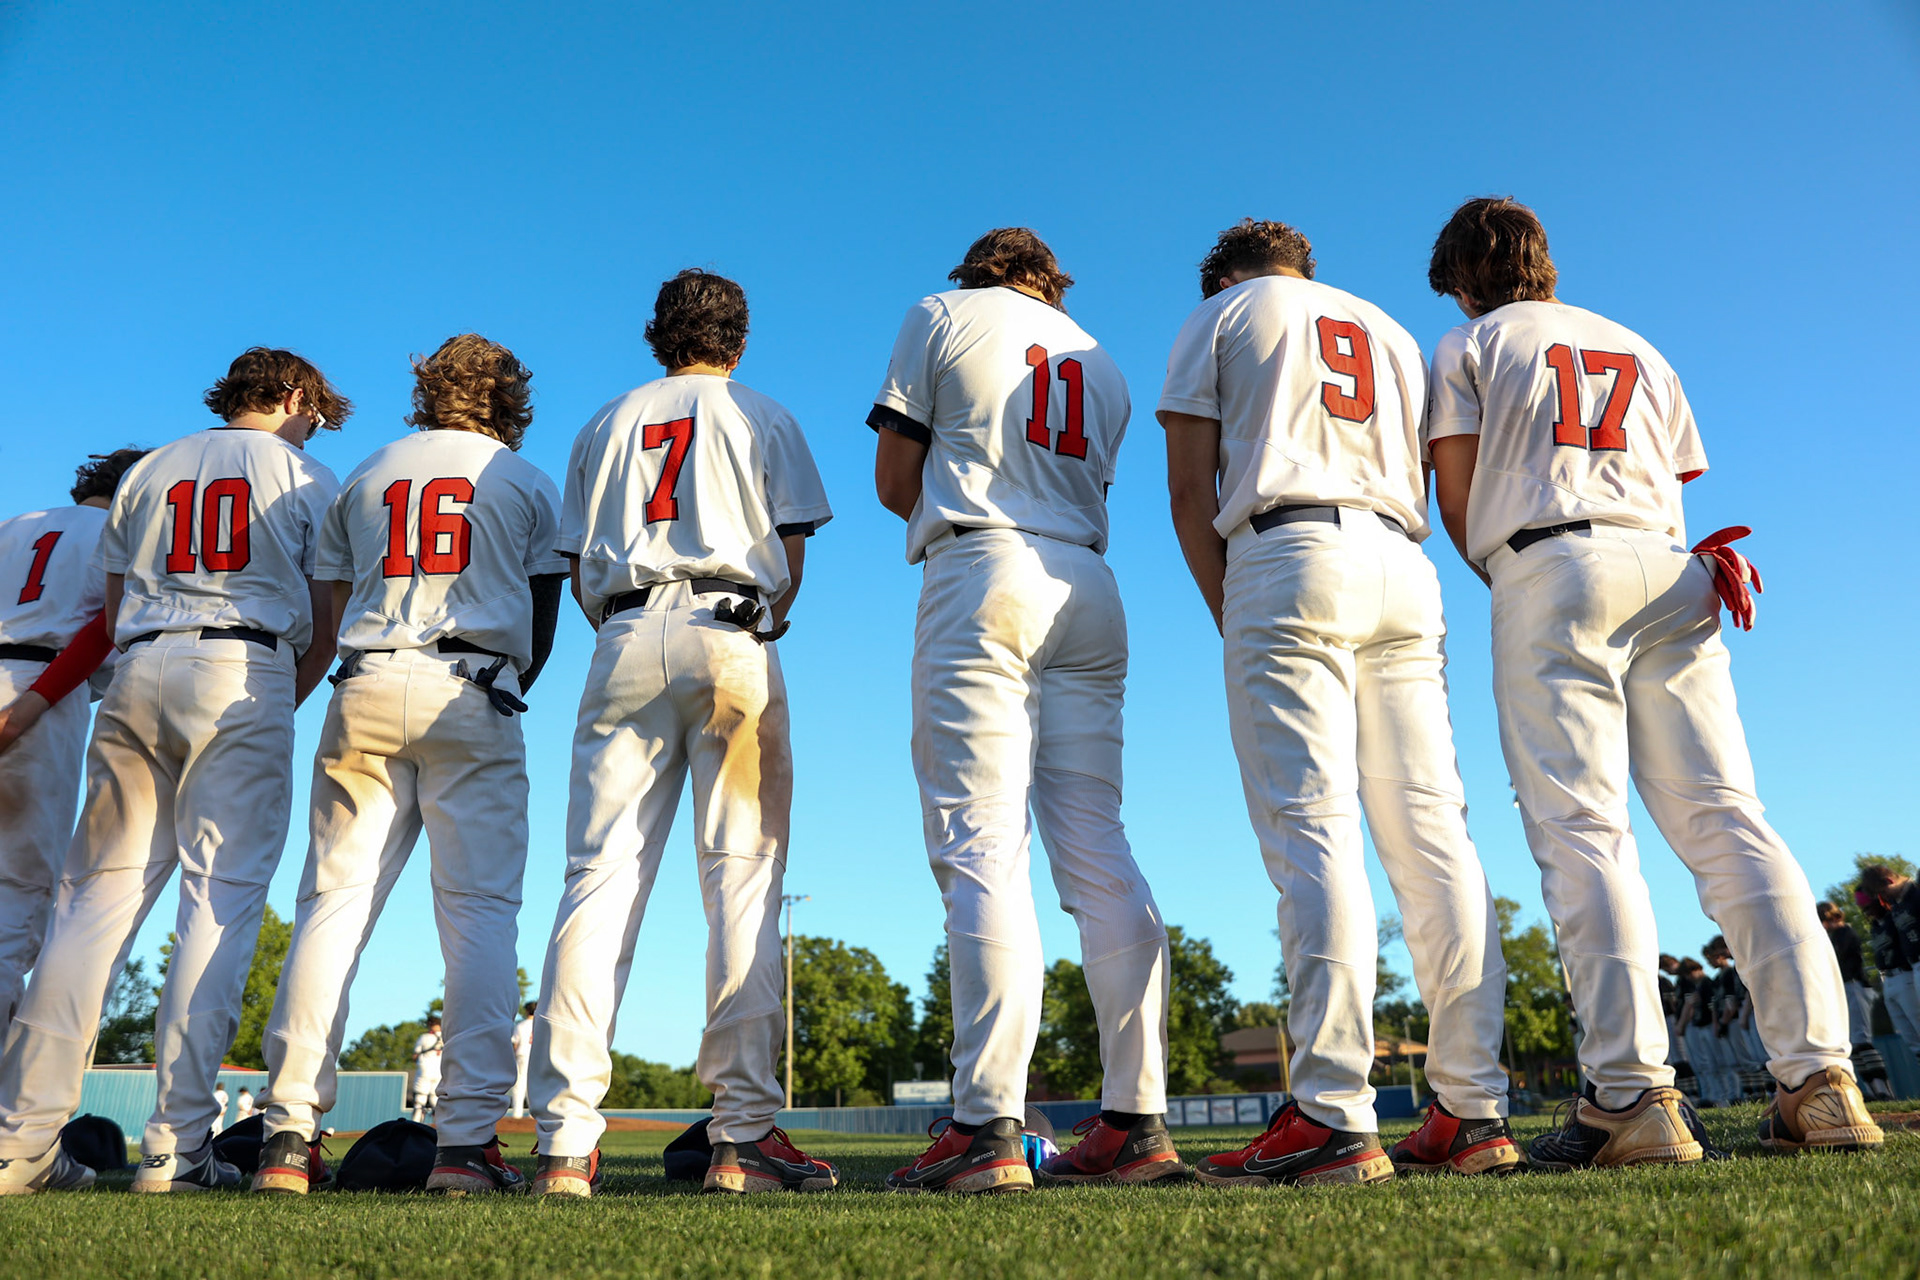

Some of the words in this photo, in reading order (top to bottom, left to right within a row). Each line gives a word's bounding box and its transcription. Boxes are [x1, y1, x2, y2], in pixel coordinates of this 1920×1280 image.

[1025, 343, 1088, 461] 11
[1315, 315, 1375, 424] 9
[1545, 342, 1639, 452] 17
[642, 416, 695, 525] 7
[17, 530, 64, 606] 1
[166, 477, 251, 575] 10
[382, 476, 475, 579] 16
